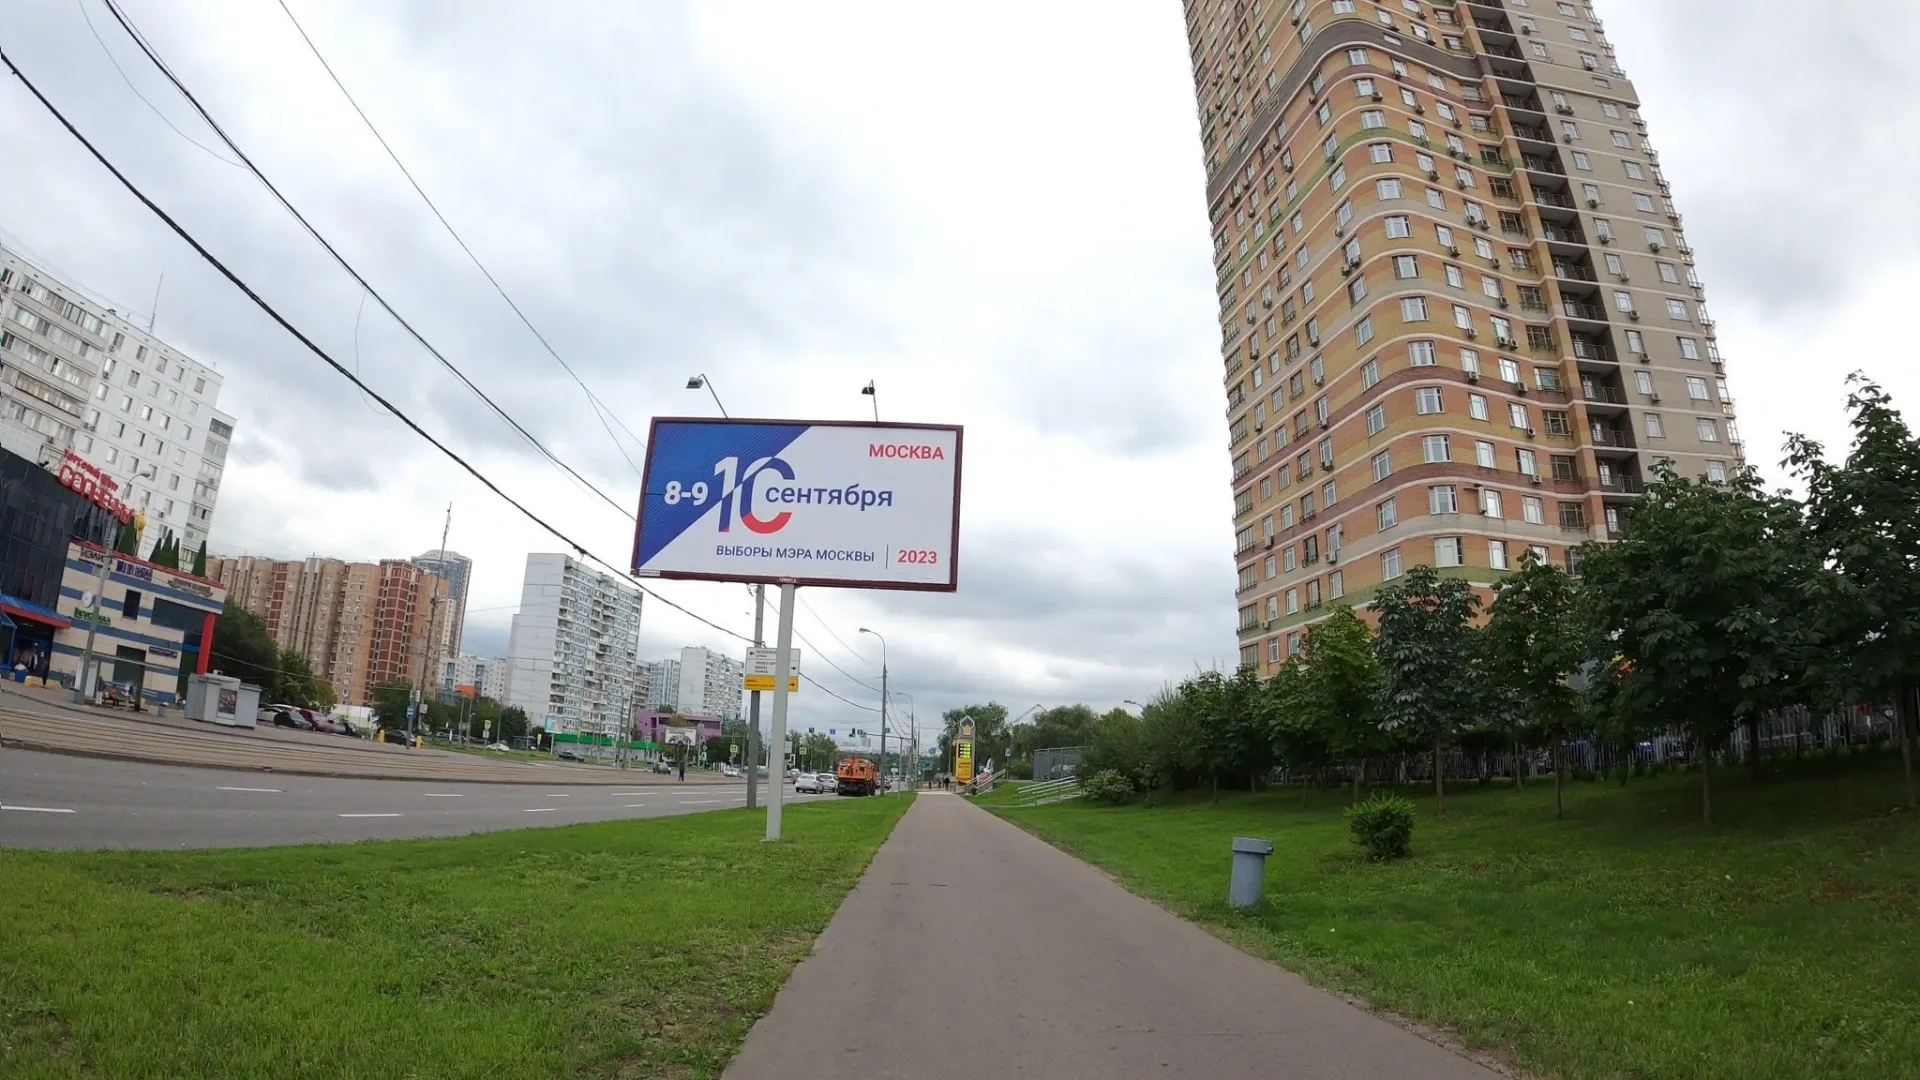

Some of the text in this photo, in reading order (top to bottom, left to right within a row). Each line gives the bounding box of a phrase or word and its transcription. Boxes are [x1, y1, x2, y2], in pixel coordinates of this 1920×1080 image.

[869, 443, 945, 461] МОСКВА
[663, 480, 709, 506] 8-9
[765, 482, 893, 511] сентября
[716, 544, 938, 564] ВЫБОРЫ МЭРА МОСКВЫ 2023
